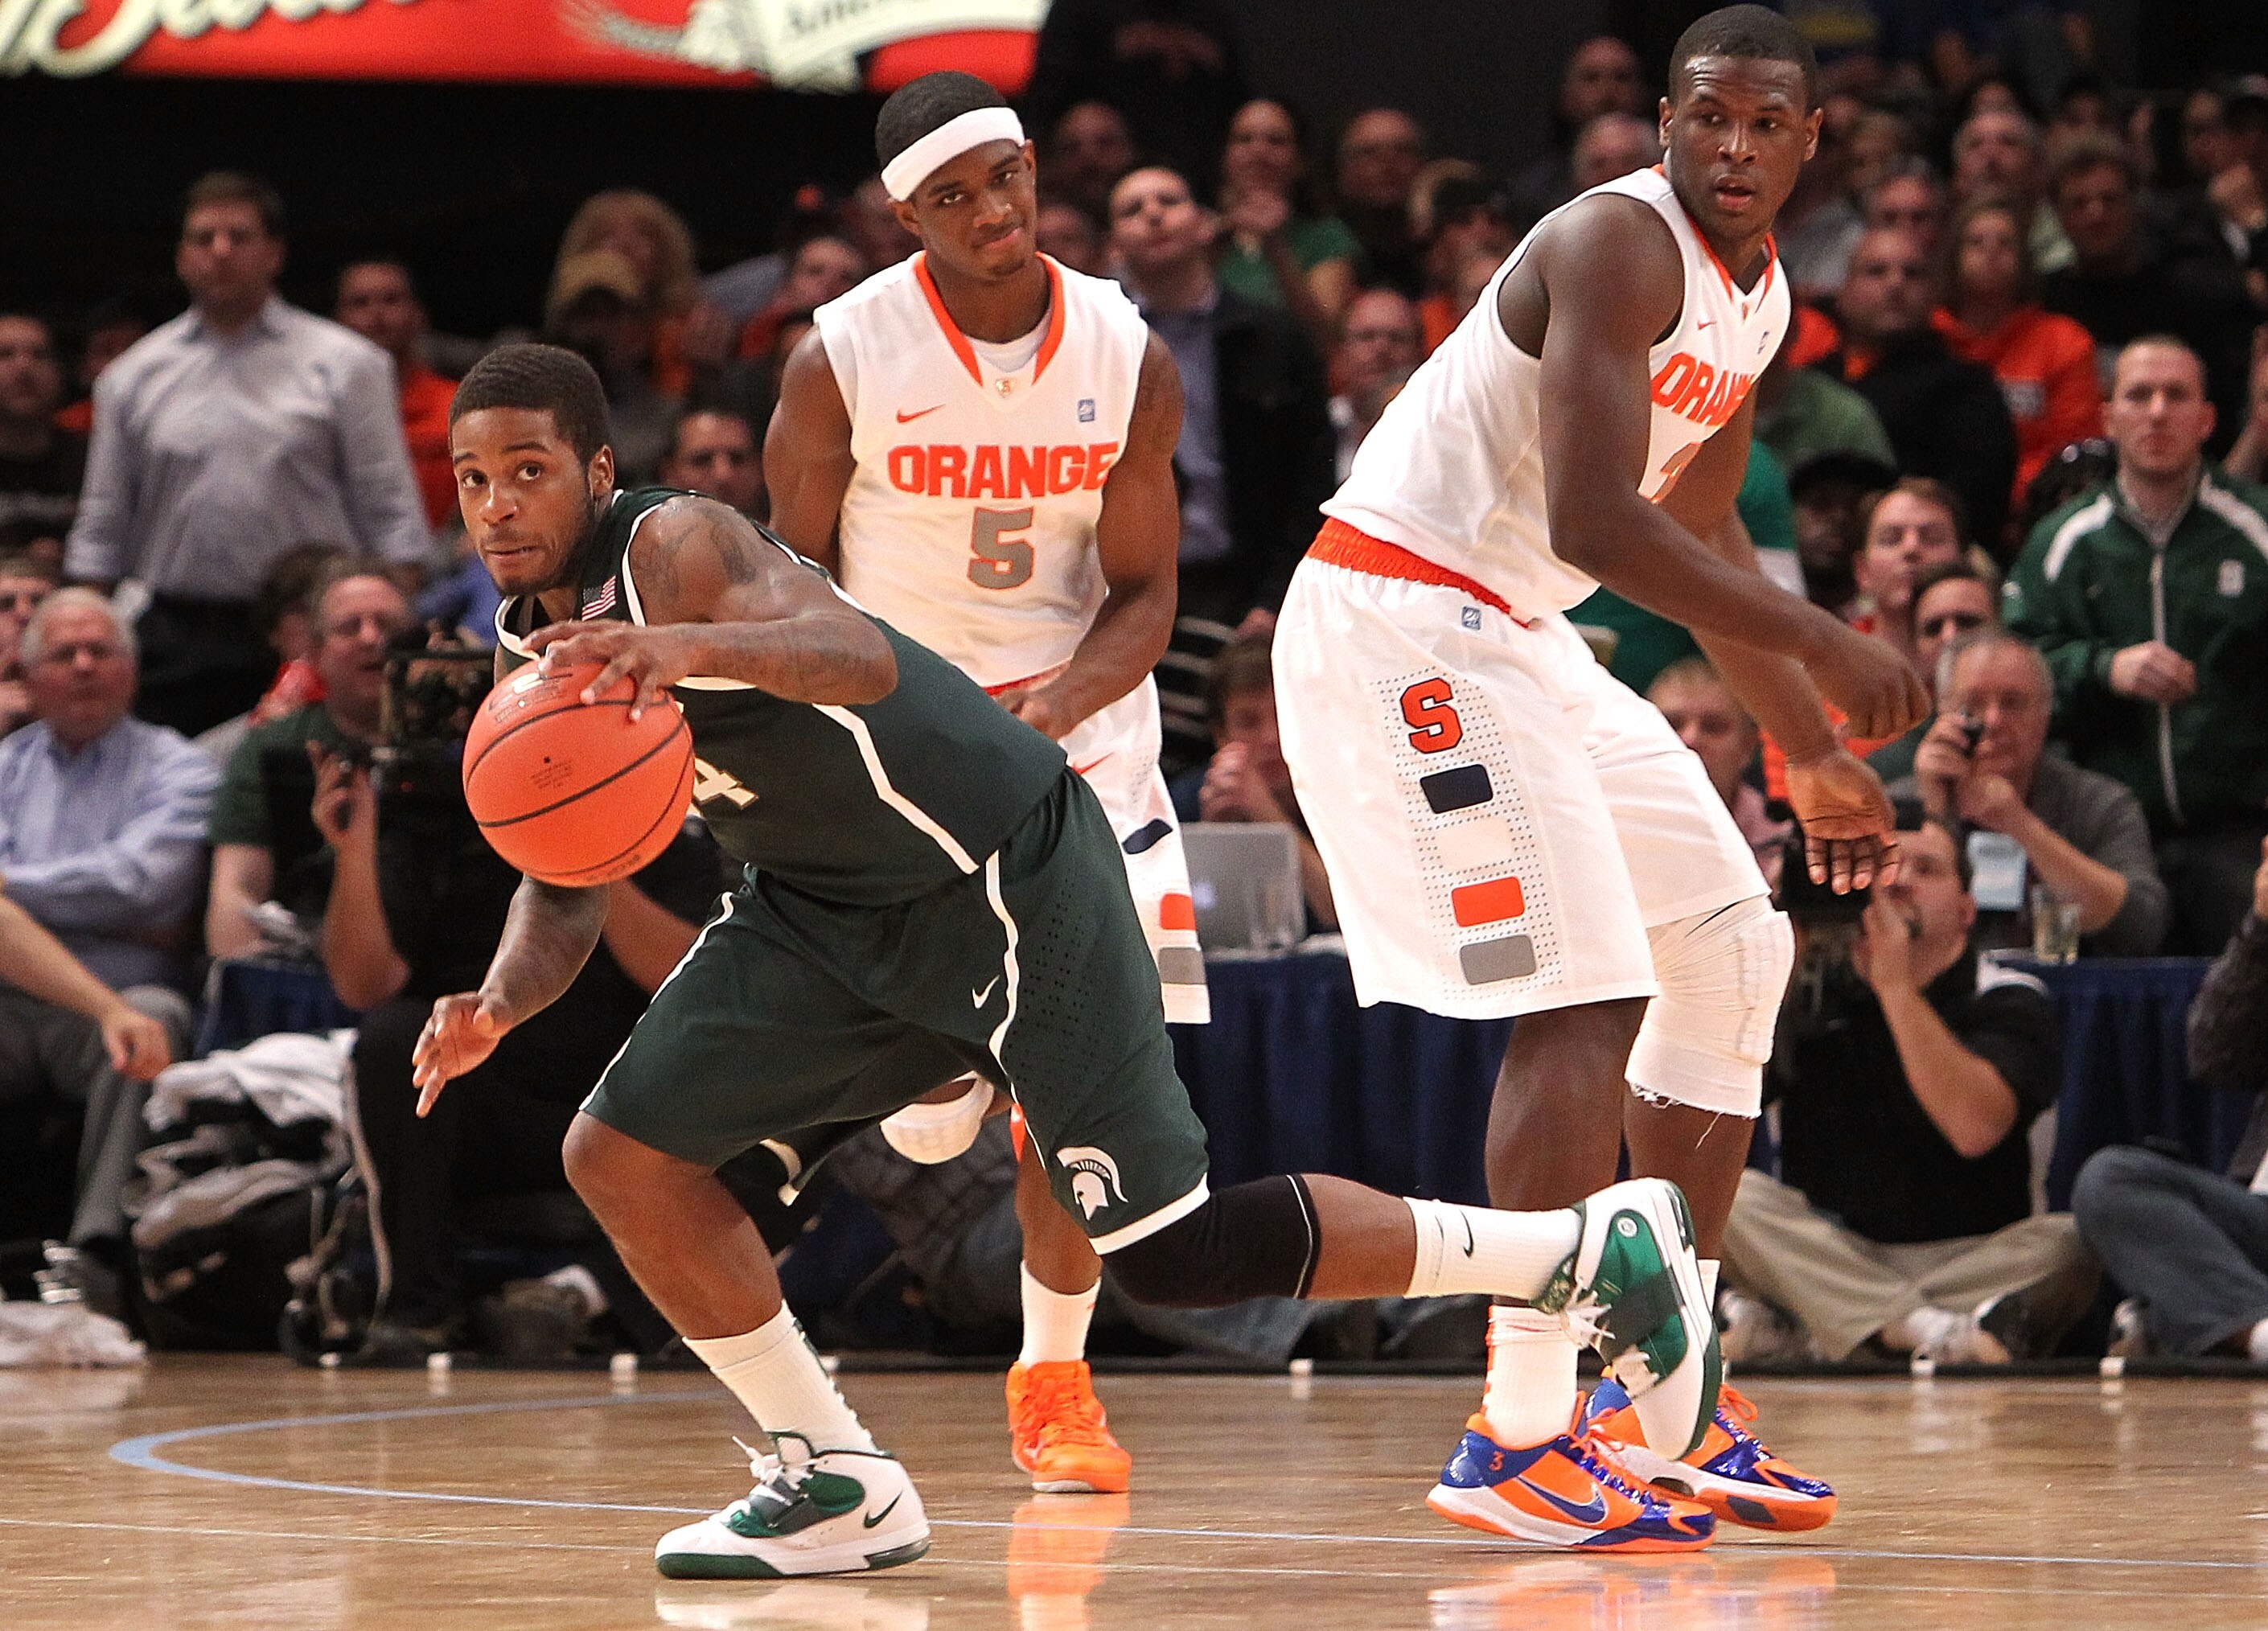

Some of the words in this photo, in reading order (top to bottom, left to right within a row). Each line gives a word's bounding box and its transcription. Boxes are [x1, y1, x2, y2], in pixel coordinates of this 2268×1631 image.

[887, 441, 1119, 499] ORANGE
[967, 506, 1034, 590] 5
[1399, 677, 1463, 754] S
[1489, 1451, 1506, 1472] 3
